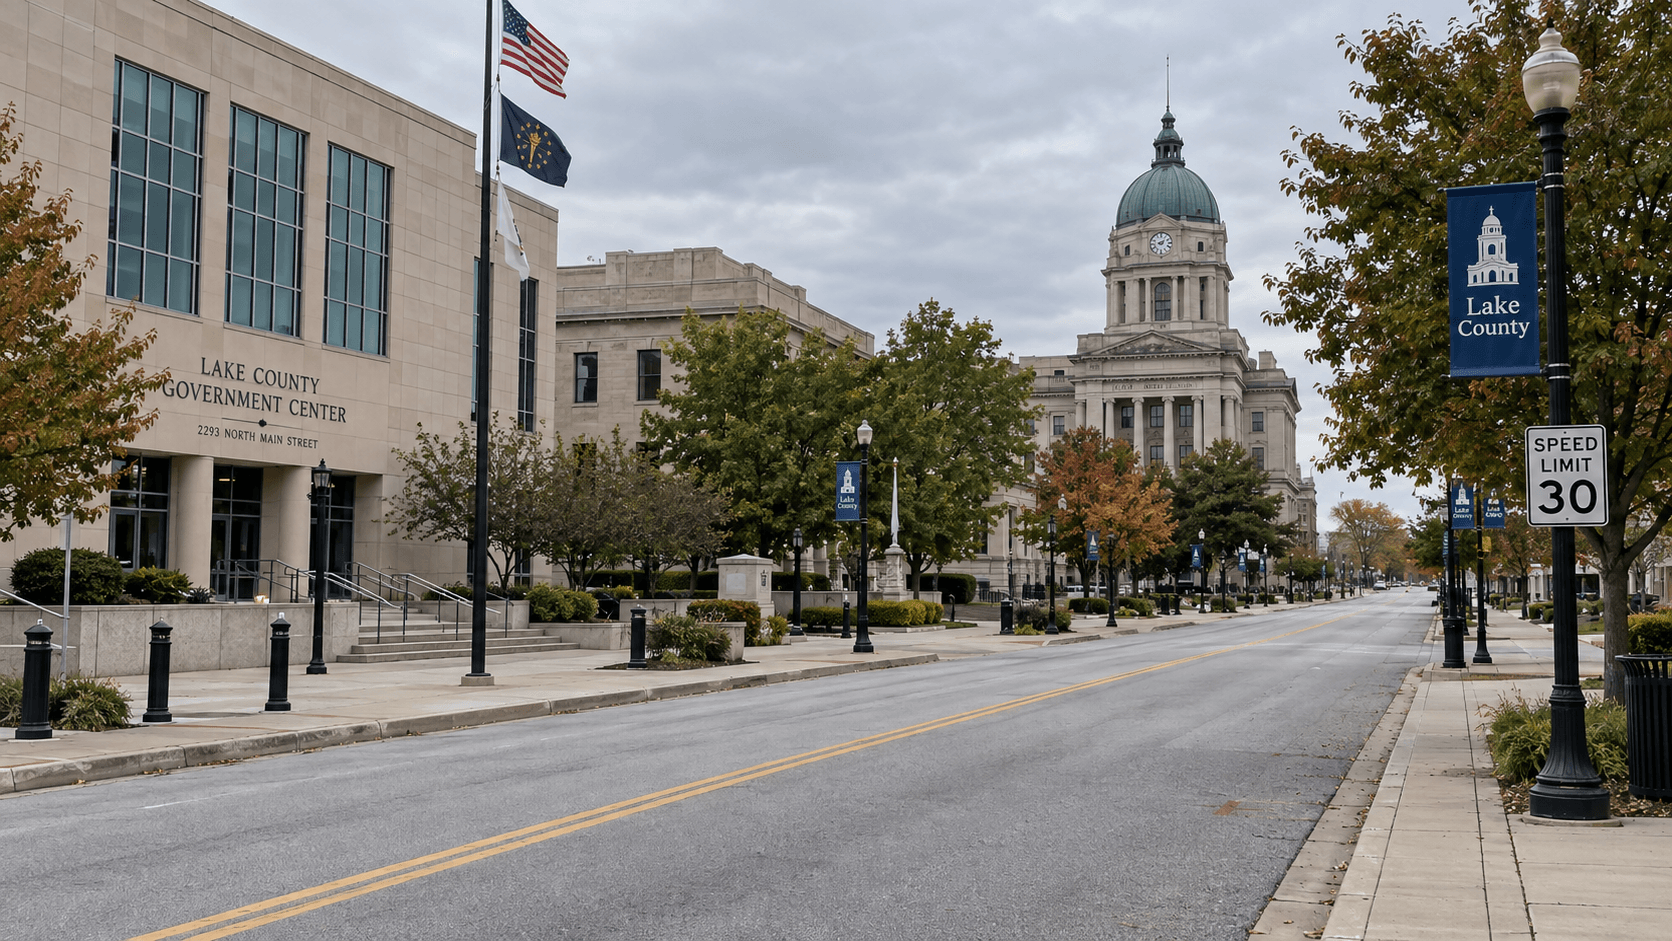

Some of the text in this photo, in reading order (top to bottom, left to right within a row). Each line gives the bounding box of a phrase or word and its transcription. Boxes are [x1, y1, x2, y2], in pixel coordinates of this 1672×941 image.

[1466, 295, 1520, 316] Lake
[1457, 319, 1530, 339] County
[201, 357, 320, 394] LAKE COUNTY
[162, 379, 347, 423] GOVERNMENT CENTER
[197, 425, 319, 449] 2293 NORTH MAIN STREET
[1534, 436, 1598, 452] SPEED
[1541, 457, 1592, 472] LIMIT
[1538, 479, 1597, 514] 30
